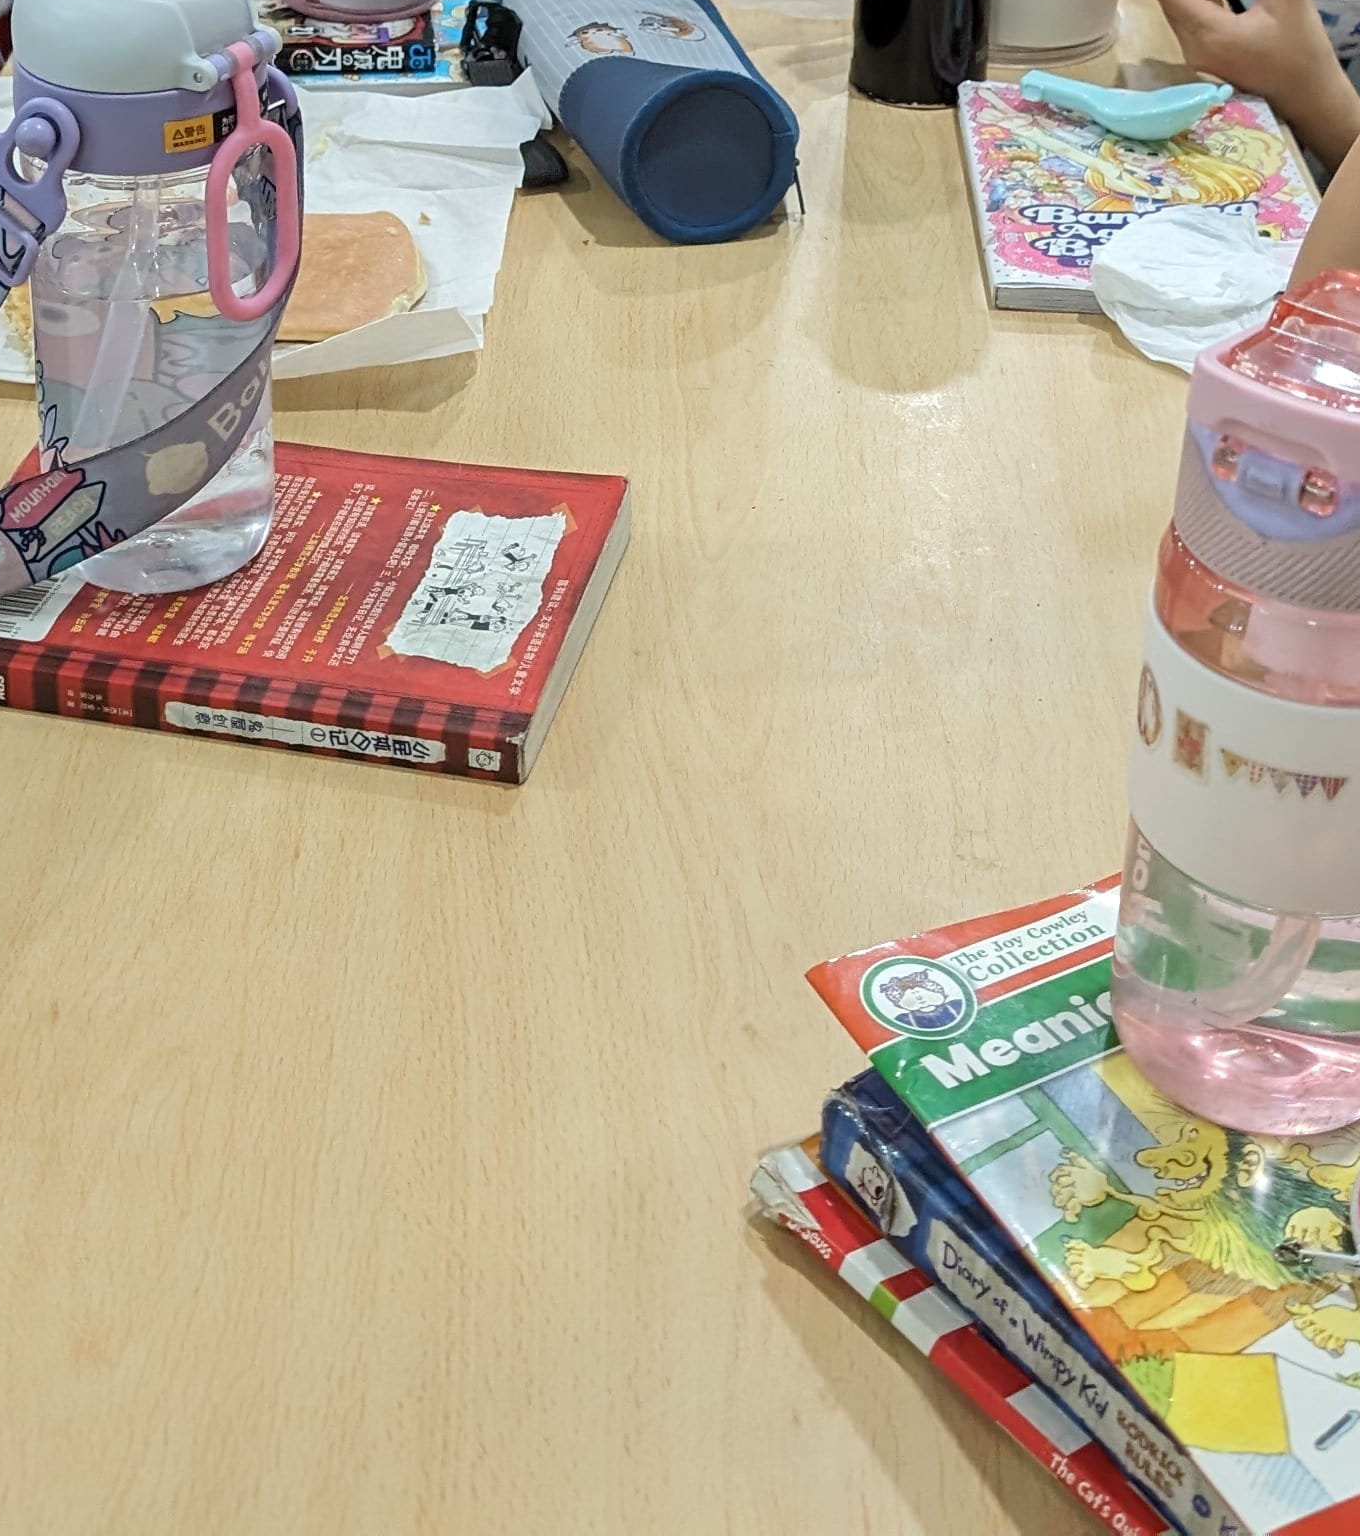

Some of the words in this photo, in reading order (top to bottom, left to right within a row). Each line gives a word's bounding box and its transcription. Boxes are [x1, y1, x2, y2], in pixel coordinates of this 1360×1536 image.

[314, 44, 404, 71] 鬼滅の刃
[950, 948, 989, 967] The
[993, 934, 1025, 954] Joy
[1026, 910, 1089, 941] Cowley
[966, 924, 1106, 983] Collection
[942, 1240, 990, 1299] Diary
[993, 1295, 1009, 1316] of
[1009, 1316, 1019, 1328] a
[1022, 1318, 1077, 1387] Wimpy
[1078, 1374, 1110, 1419] Kid
[1115, 1409, 1185, 1487] RODRICK
[1125, 1441, 1175, 1499] RULES
[1049, 1453, 1076, 1485] The
[1077, 1479, 1112, 1518] Cat's
